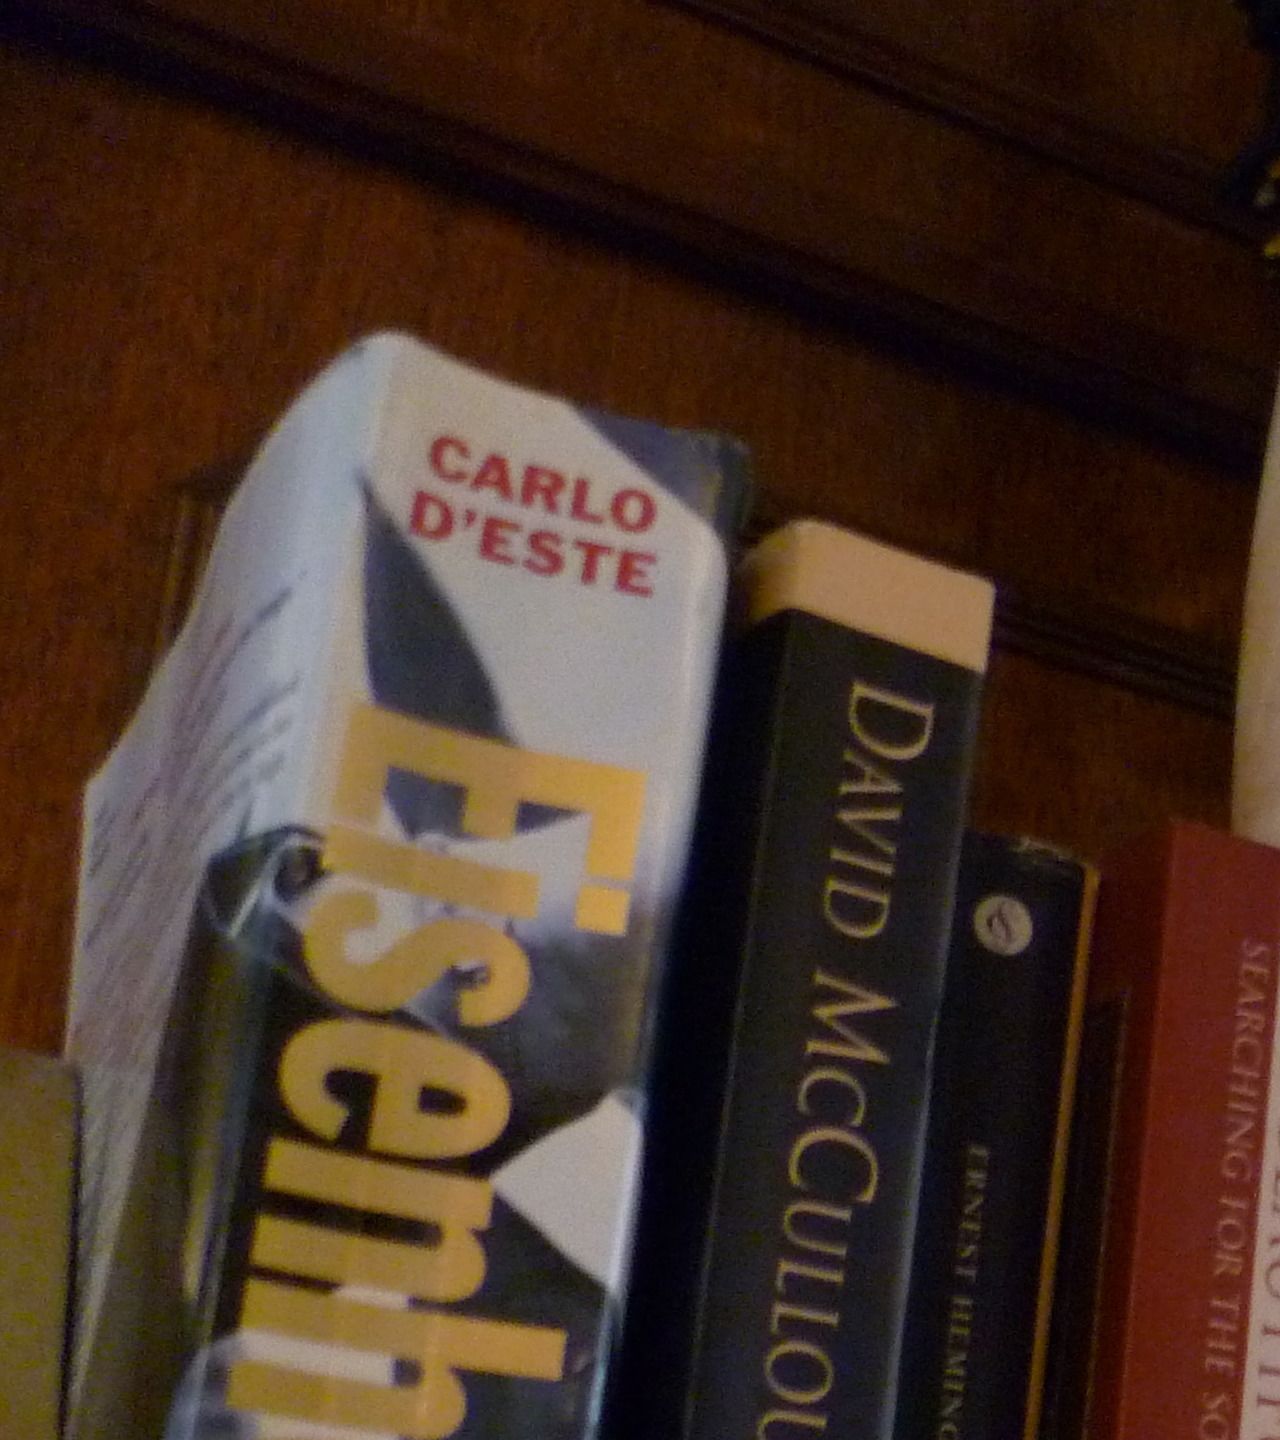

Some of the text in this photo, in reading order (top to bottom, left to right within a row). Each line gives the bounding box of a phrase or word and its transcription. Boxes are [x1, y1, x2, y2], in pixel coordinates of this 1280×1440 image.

[428, 436, 658, 533] CARLO
[408, 489, 658, 598] D'ESTE
[823, 682, 935, 939] DAVID
[1218, 939, 1268, 1181] SEARCHING
[1212, 1194, 1255, 1276] FOR
[1204, 1300, 1241, 1374] THE
